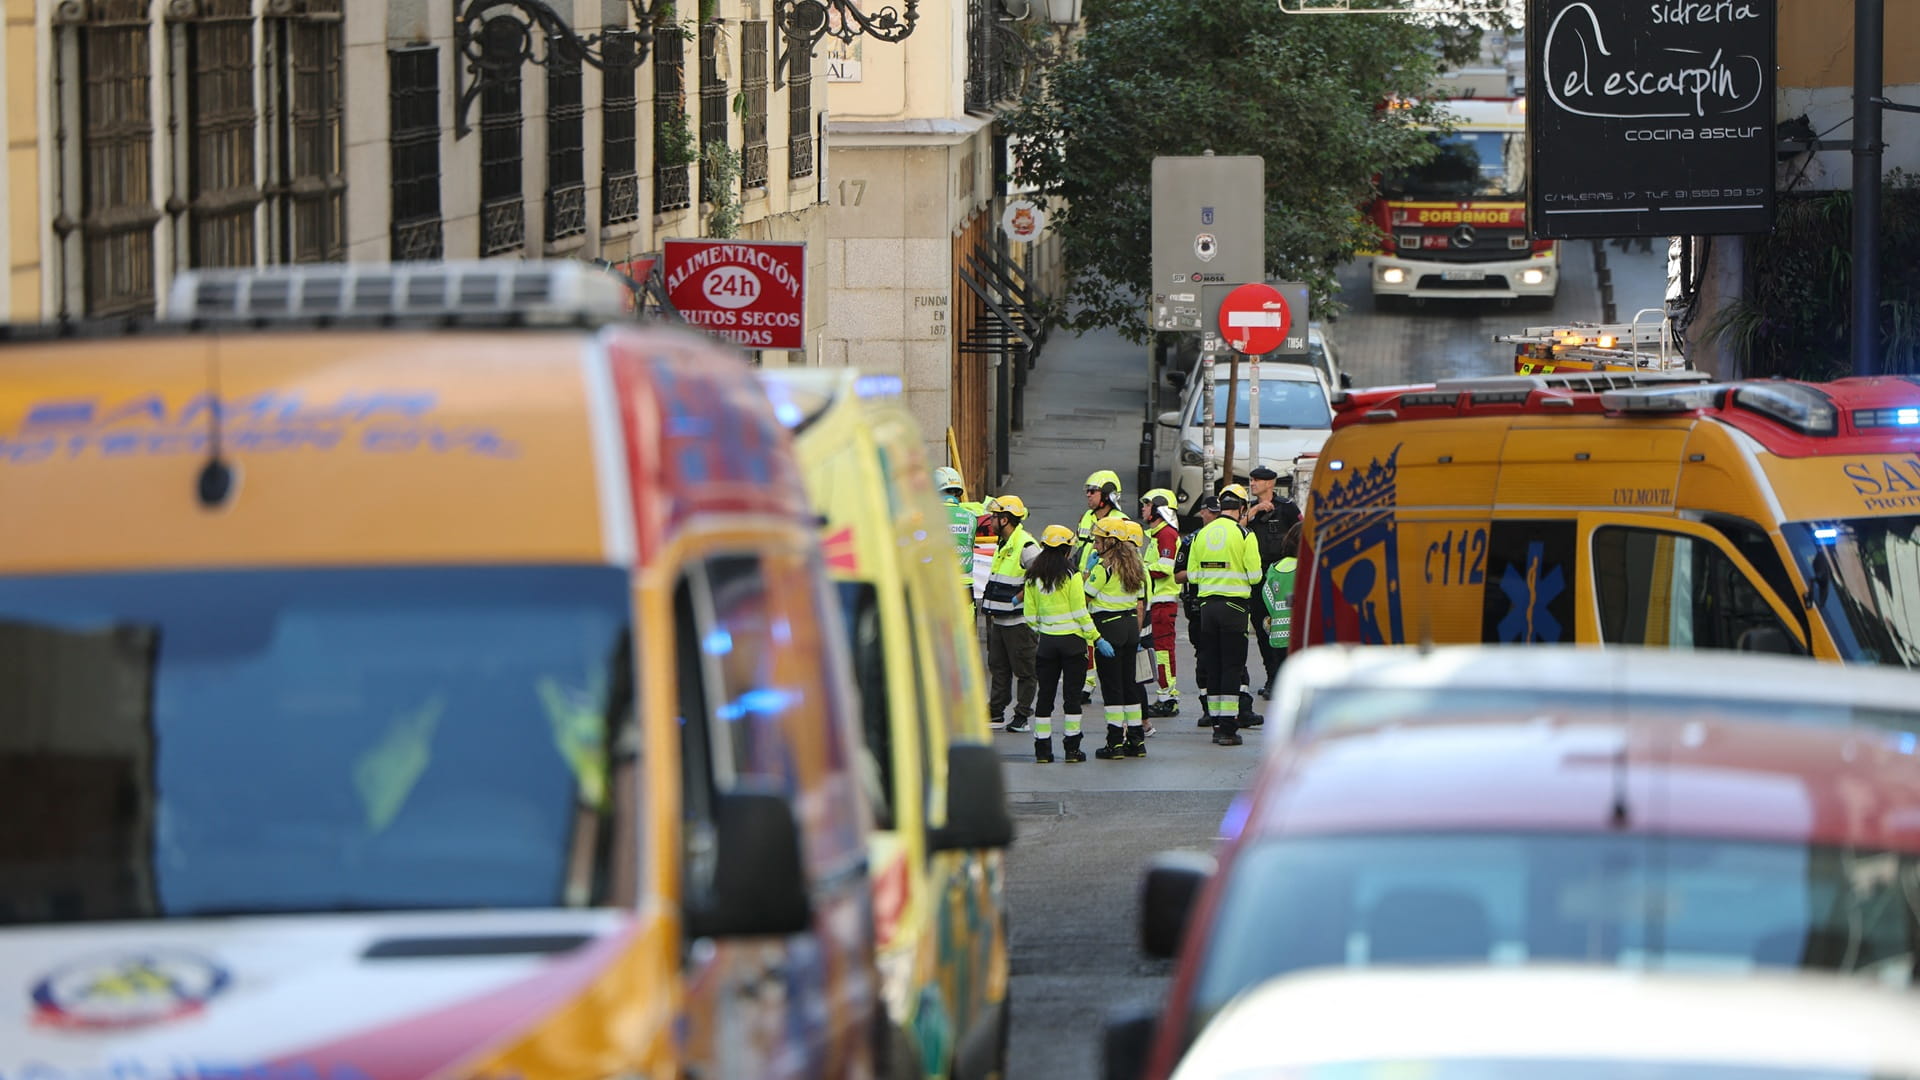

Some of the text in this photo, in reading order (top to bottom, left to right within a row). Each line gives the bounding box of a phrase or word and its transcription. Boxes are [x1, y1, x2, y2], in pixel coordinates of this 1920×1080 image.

[1603, 48, 1740, 117] escarpín
[1624, 126, 1763, 142] cocina astur
[837, 179, 867, 207] 17
[667, 245, 800, 298] ALIMENTACIÓN
[709, 274, 755, 297] 24h
[741, 312, 800, 327] SECOS
